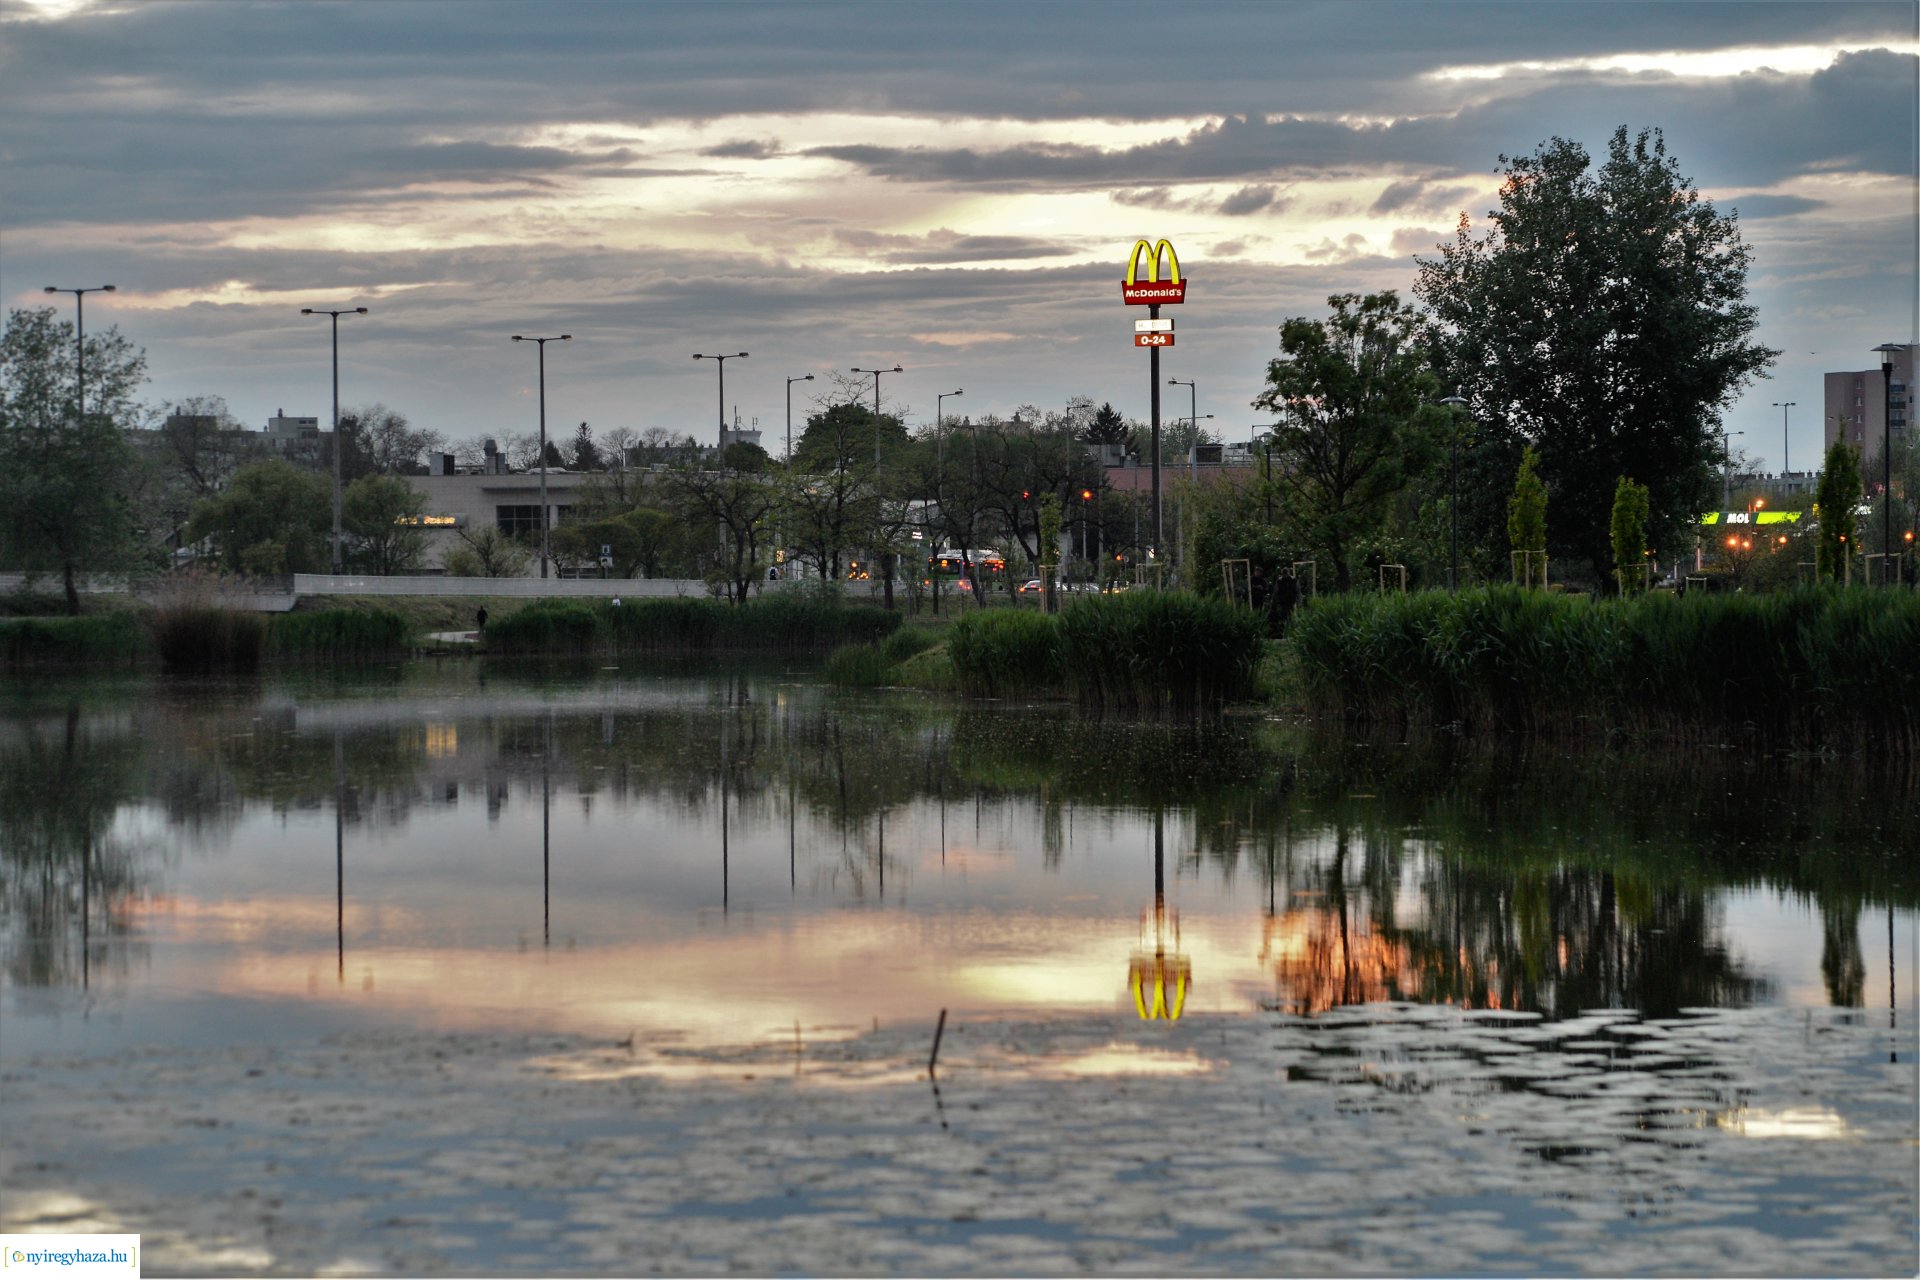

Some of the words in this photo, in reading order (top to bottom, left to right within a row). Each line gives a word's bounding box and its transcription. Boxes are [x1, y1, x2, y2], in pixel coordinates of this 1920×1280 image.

[1126, 289, 1182, 298] McDonald's
[1141, 336, 1166, 345] 0-24
[1726, 513, 1750, 524] MOL
